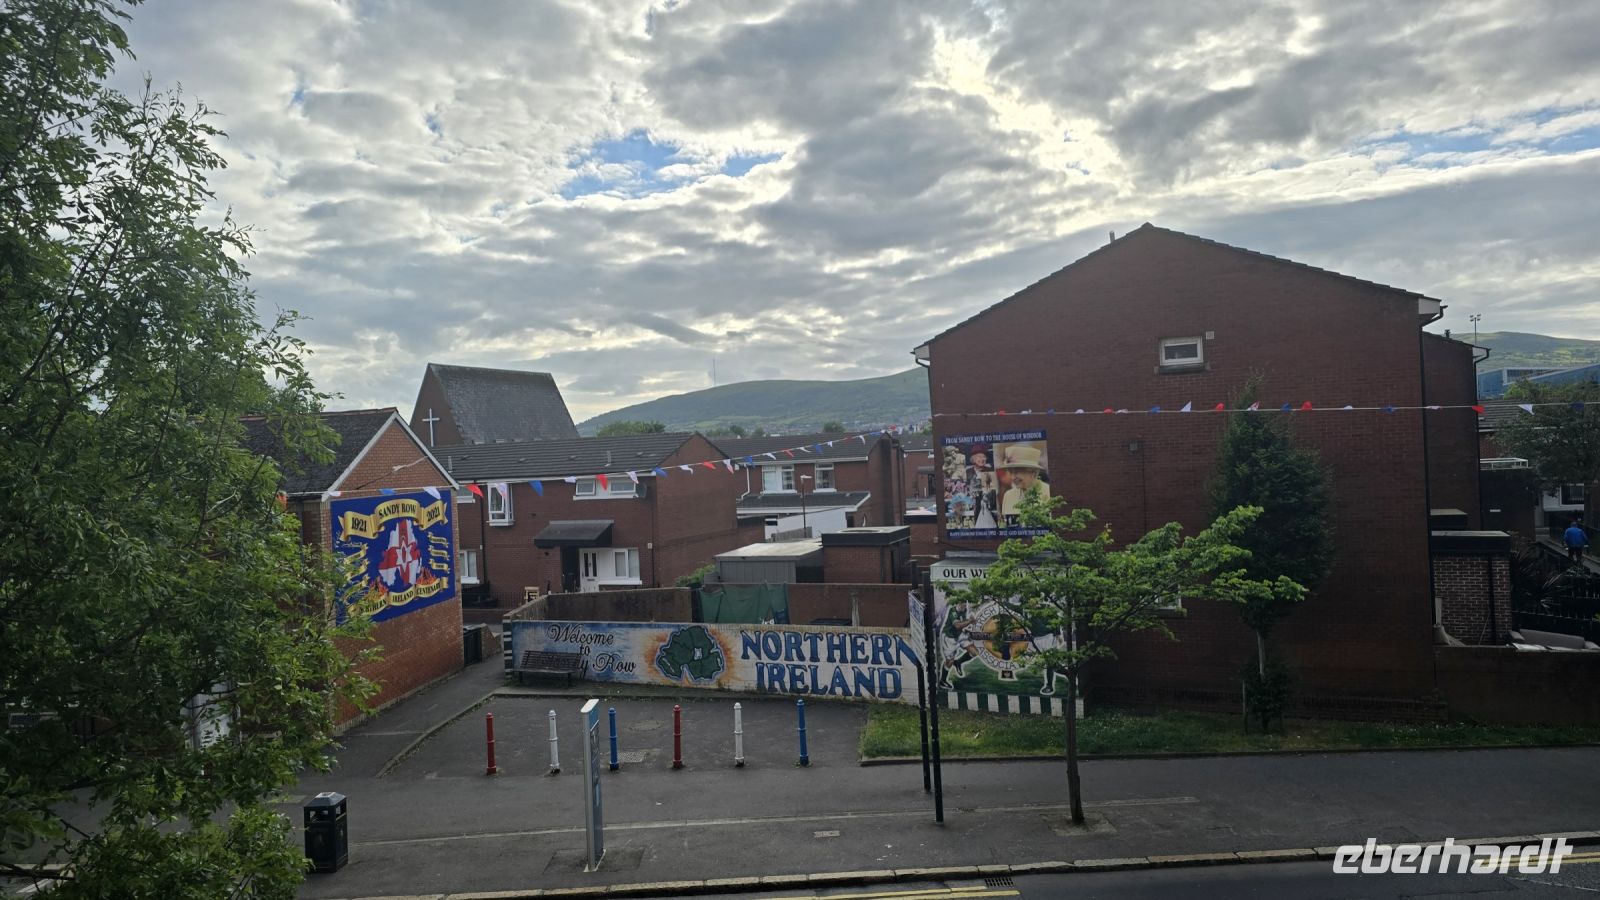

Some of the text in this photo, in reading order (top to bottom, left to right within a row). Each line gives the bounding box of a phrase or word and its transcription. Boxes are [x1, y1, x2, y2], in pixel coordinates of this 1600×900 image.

[352, 503, 441, 532] 1921 SANDY ROW 2021
[943, 568, 967, 578] OUR
[392, 590, 413, 603] IRELAND
[547, 624, 614, 646] Welcome
[579, 644, 590, 656] to
[740, 629, 917, 667] NORTHERN
[592, 652, 636, 674] Row
[755, 662, 902, 699] IRELAND
